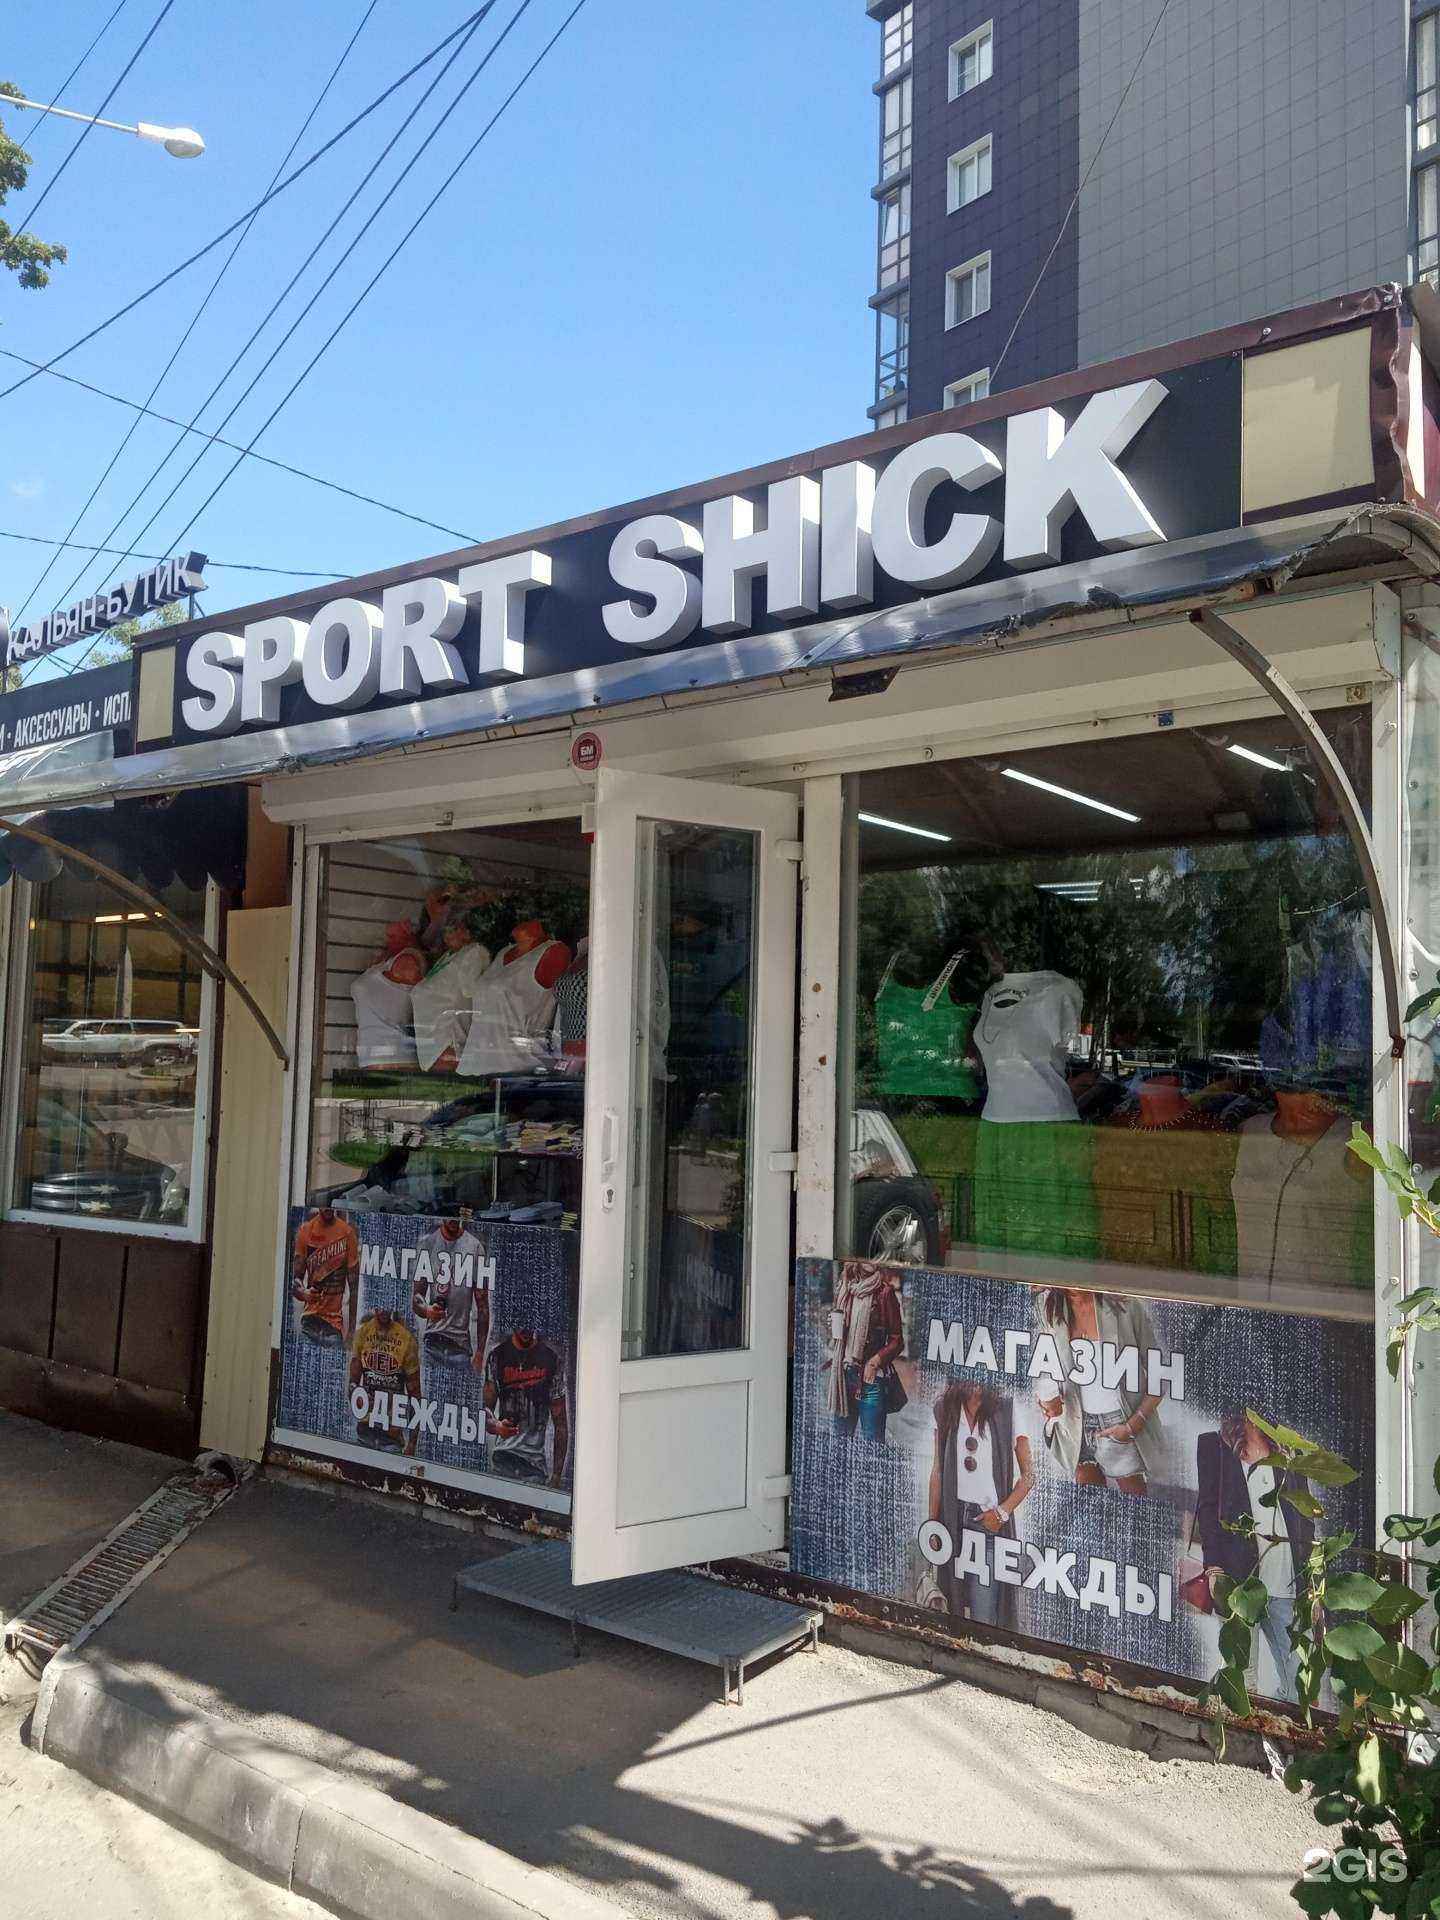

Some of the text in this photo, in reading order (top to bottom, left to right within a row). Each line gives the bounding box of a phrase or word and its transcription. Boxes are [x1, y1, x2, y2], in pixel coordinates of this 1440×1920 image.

[181, 377, 1170, 734] SPORT SHICK
[7, 551, 206, 666] КАЛЬЯН-БУТИК
[13, 700, 93, 748] АКСЕССУАРЫ
[358, 1244, 497, 1291] МАГАЗИН
[926, 1318, 1186, 1402] МАГАЗИН
[350, 1387, 487, 1445] ОДЕЖДЫ
[917, 1520, 1174, 1622] ОДЕЖДЫ
